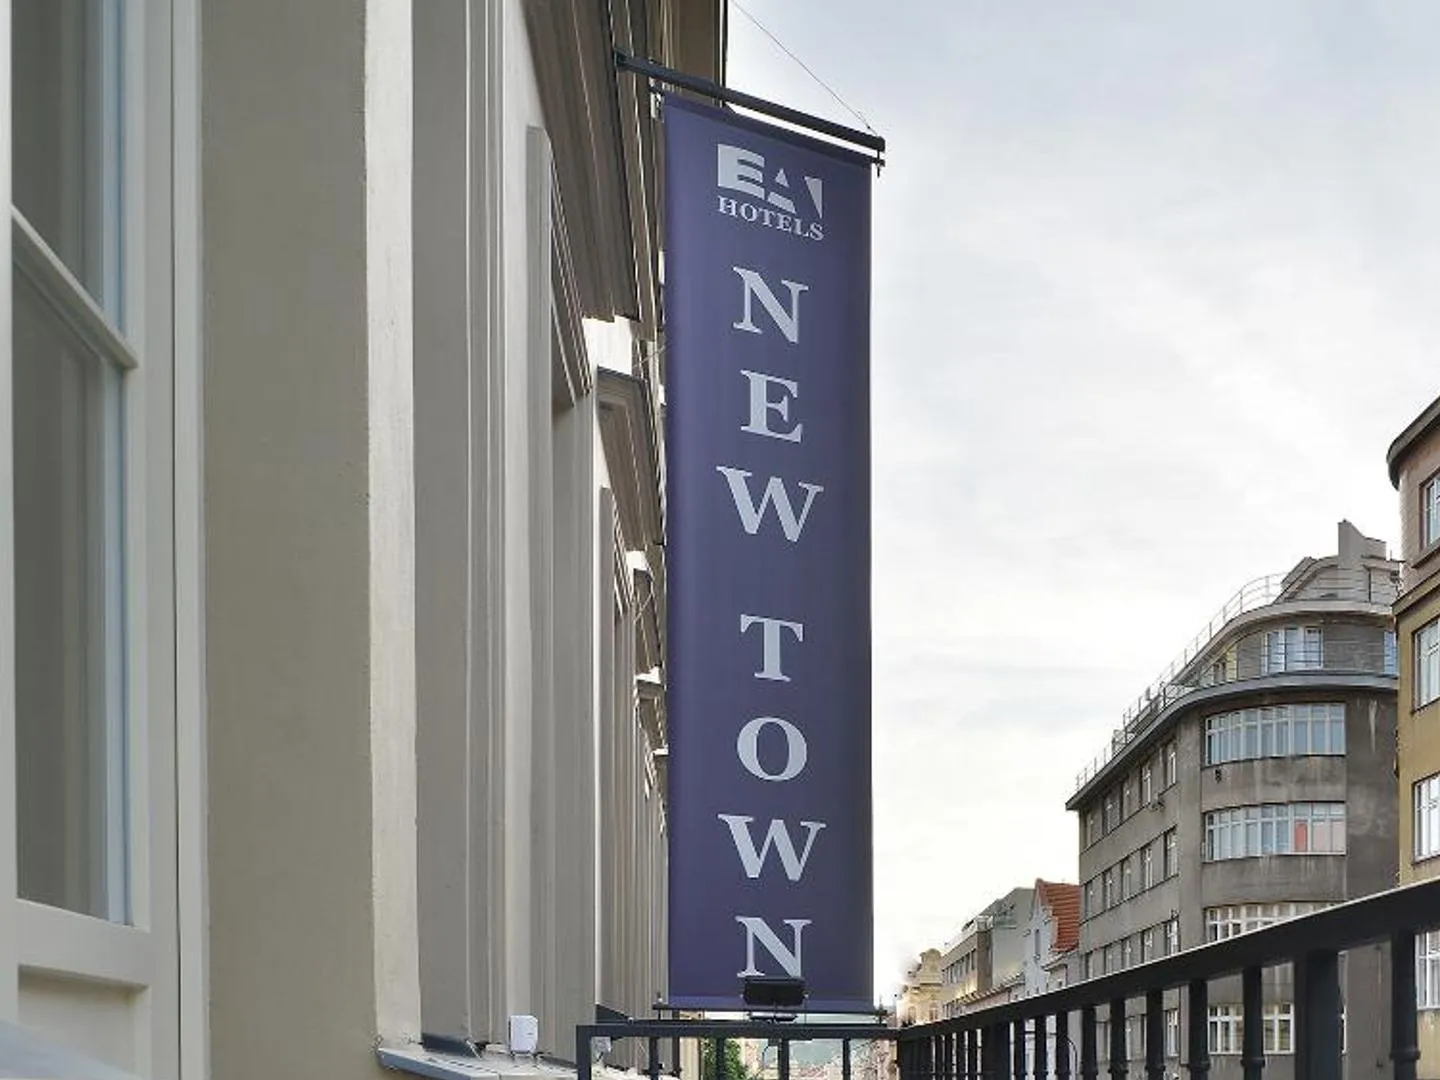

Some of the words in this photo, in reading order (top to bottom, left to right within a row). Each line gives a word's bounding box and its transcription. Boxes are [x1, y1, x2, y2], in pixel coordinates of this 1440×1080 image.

[717, 195, 825, 241] HOTELS
[716, 266, 825, 543] NEW
[717, 613, 827, 979] TOWN
